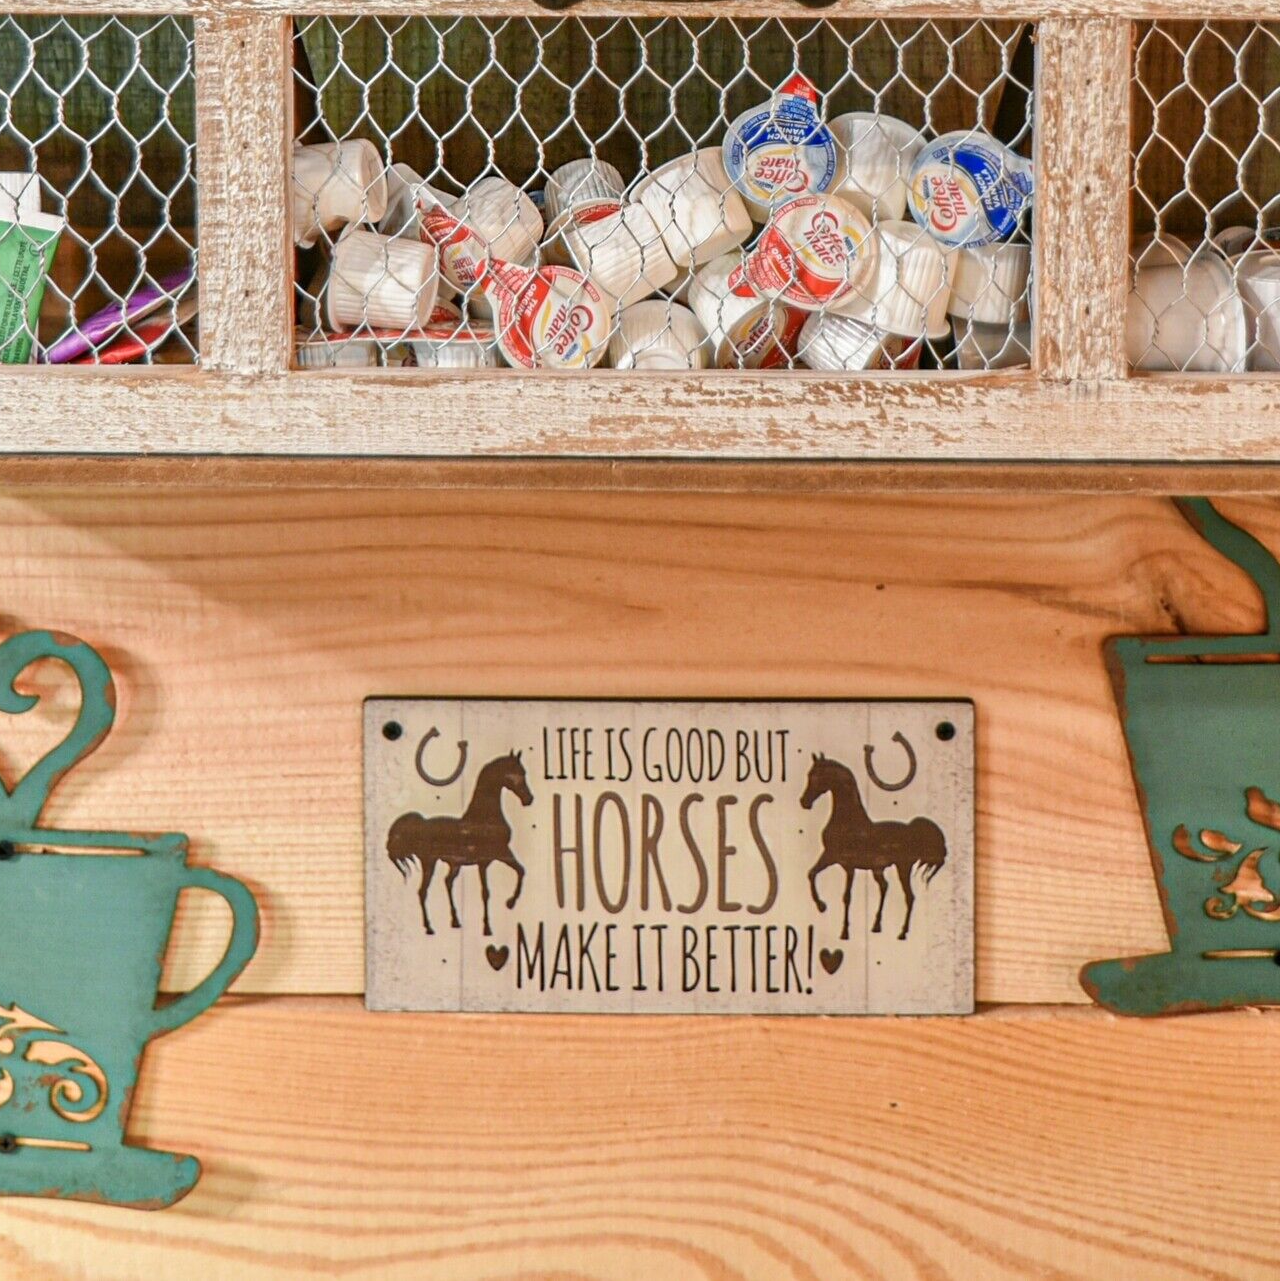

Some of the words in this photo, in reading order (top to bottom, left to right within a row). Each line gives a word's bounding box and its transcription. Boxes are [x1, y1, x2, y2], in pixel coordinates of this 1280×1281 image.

[932, 176, 956, 230] Coffee
[554, 307, 592, 356] Coffee
[542, 726, 596, 781] LIFE
[604, 727, 632, 782] IS
[641, 726, 726, 784] GOOD
[734, 729, 790, 783] BUT
[551, 790, 780, 915] HORSES
[516, 921, 620, 993] MAKE
[632, 924, 668, 993] IT
[681, 923, 816, 995] BETTER!
